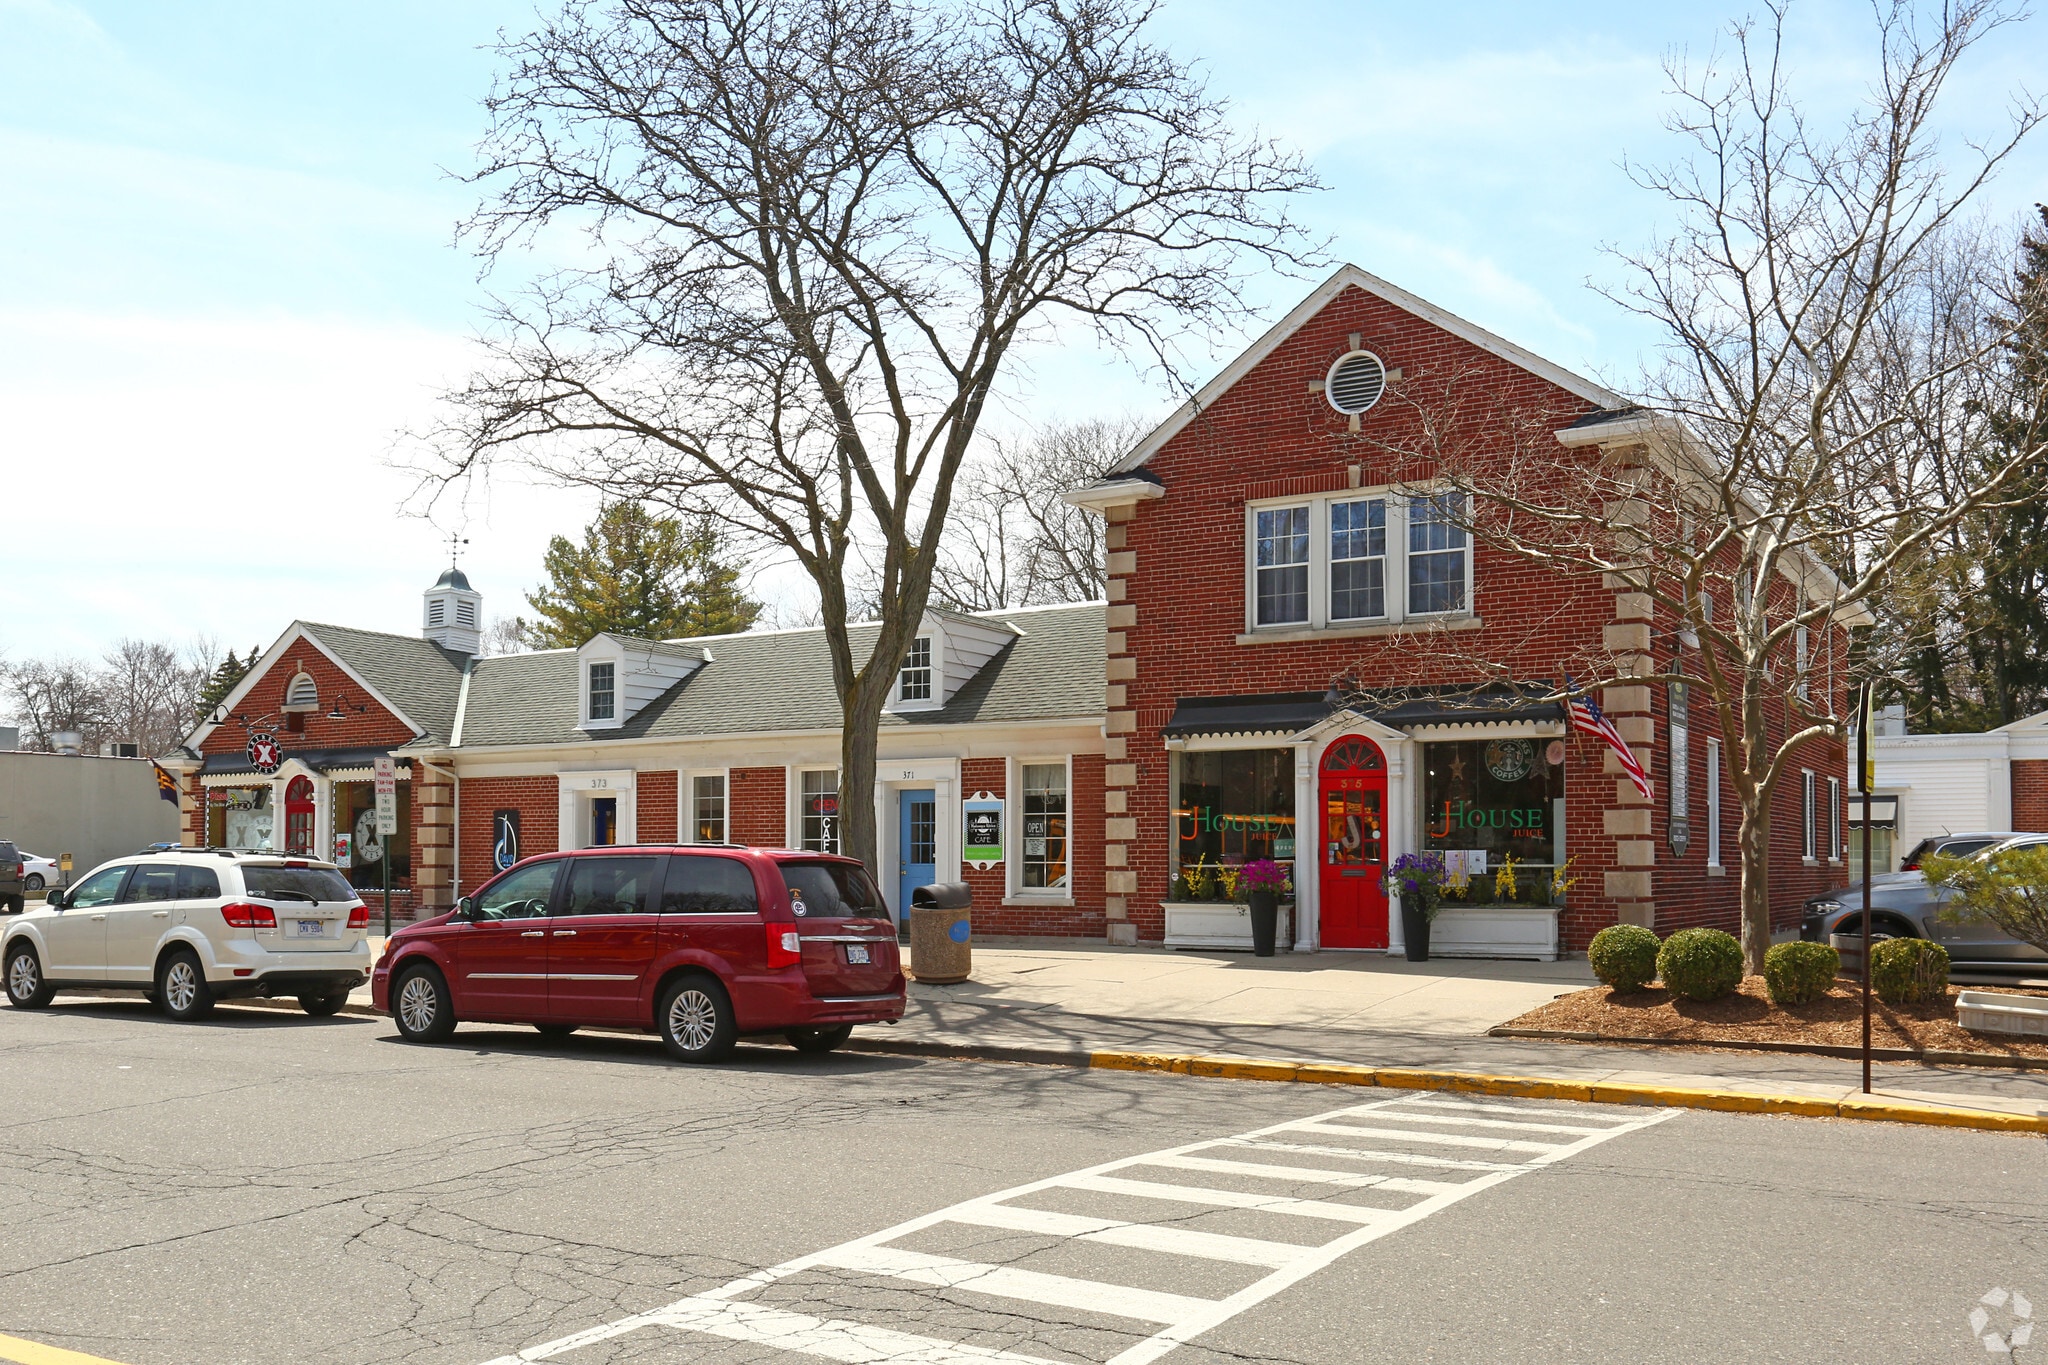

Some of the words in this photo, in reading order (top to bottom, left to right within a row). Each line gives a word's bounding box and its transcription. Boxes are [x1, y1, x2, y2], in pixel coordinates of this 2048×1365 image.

[256, 744, 274, 764] X
[902, 770, 914, 779] 371
[1492, 766, 1525, 779] COFFEE
[591, 778, 607, 789] 373
[1027, 822, 1044, 833] OPEN
[1513, 829, 1544, 837] JUICE
[822, 817, 831, 853] CAF
[1251, 832, 1278, 840] JUICE
